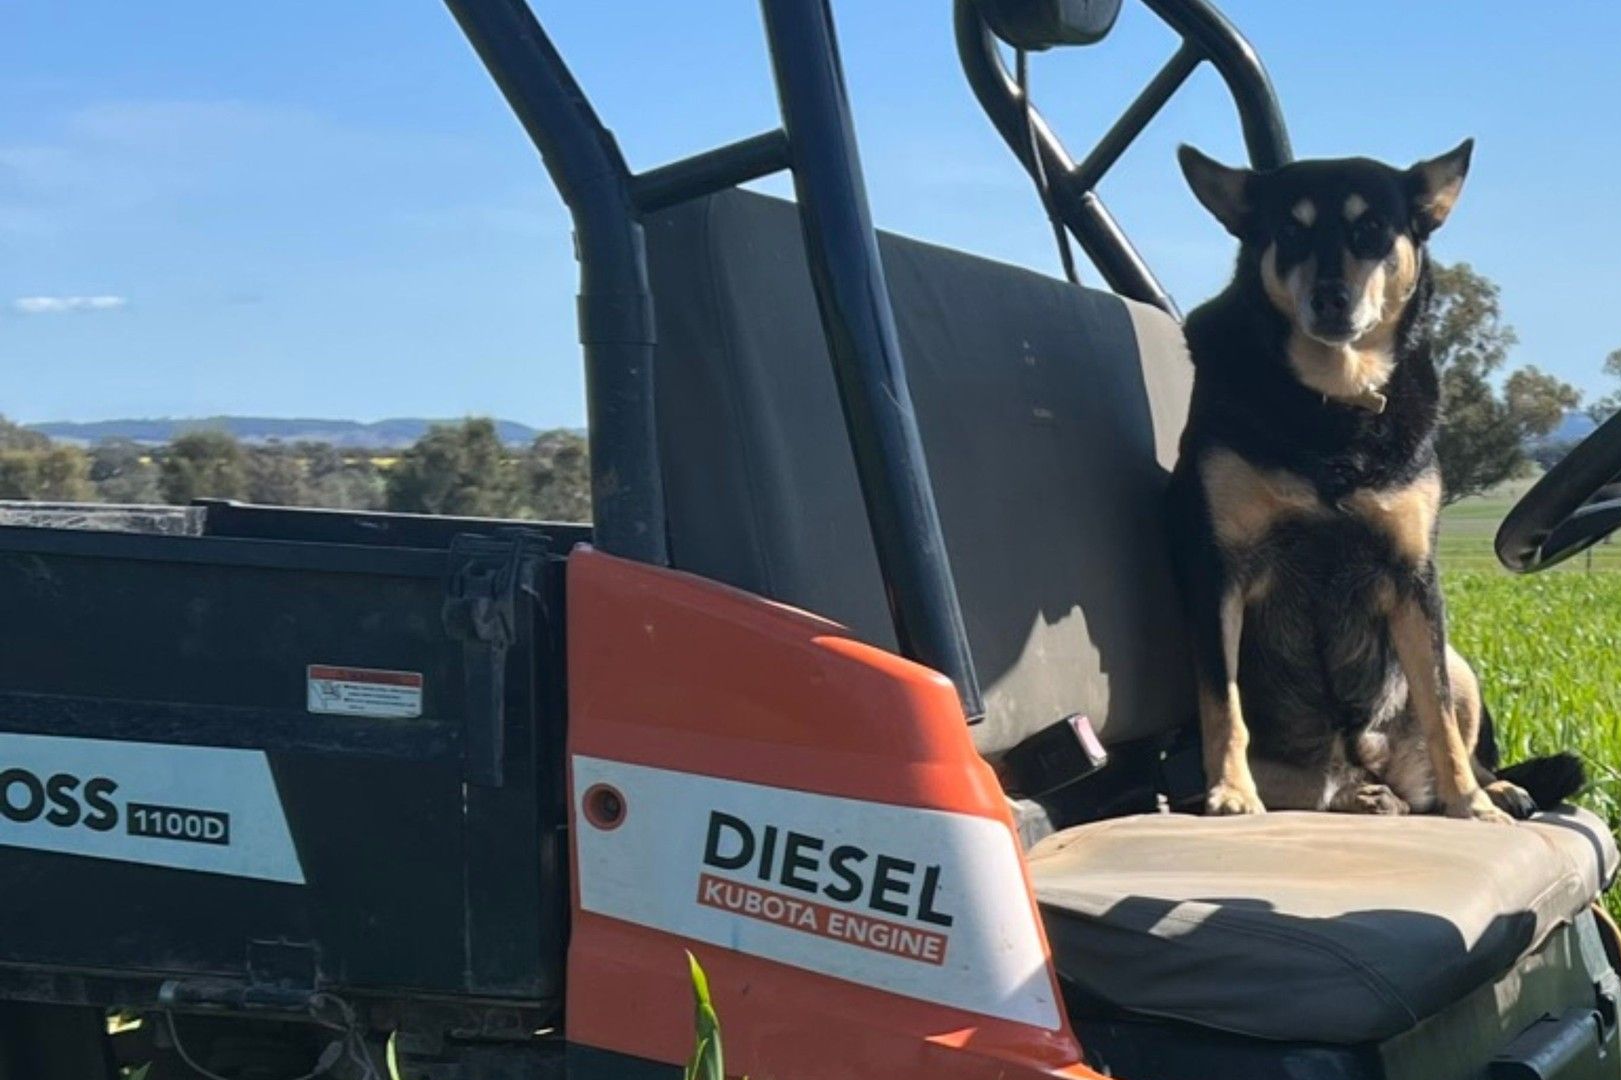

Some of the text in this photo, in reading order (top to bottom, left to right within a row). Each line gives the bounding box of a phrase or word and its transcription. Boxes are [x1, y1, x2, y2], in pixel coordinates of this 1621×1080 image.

[134, 809, 225, 840] 1100D
[703, 810, 953, 927] DIESEL
[704, 879, 940, 960] KUBOTA ENGINE
